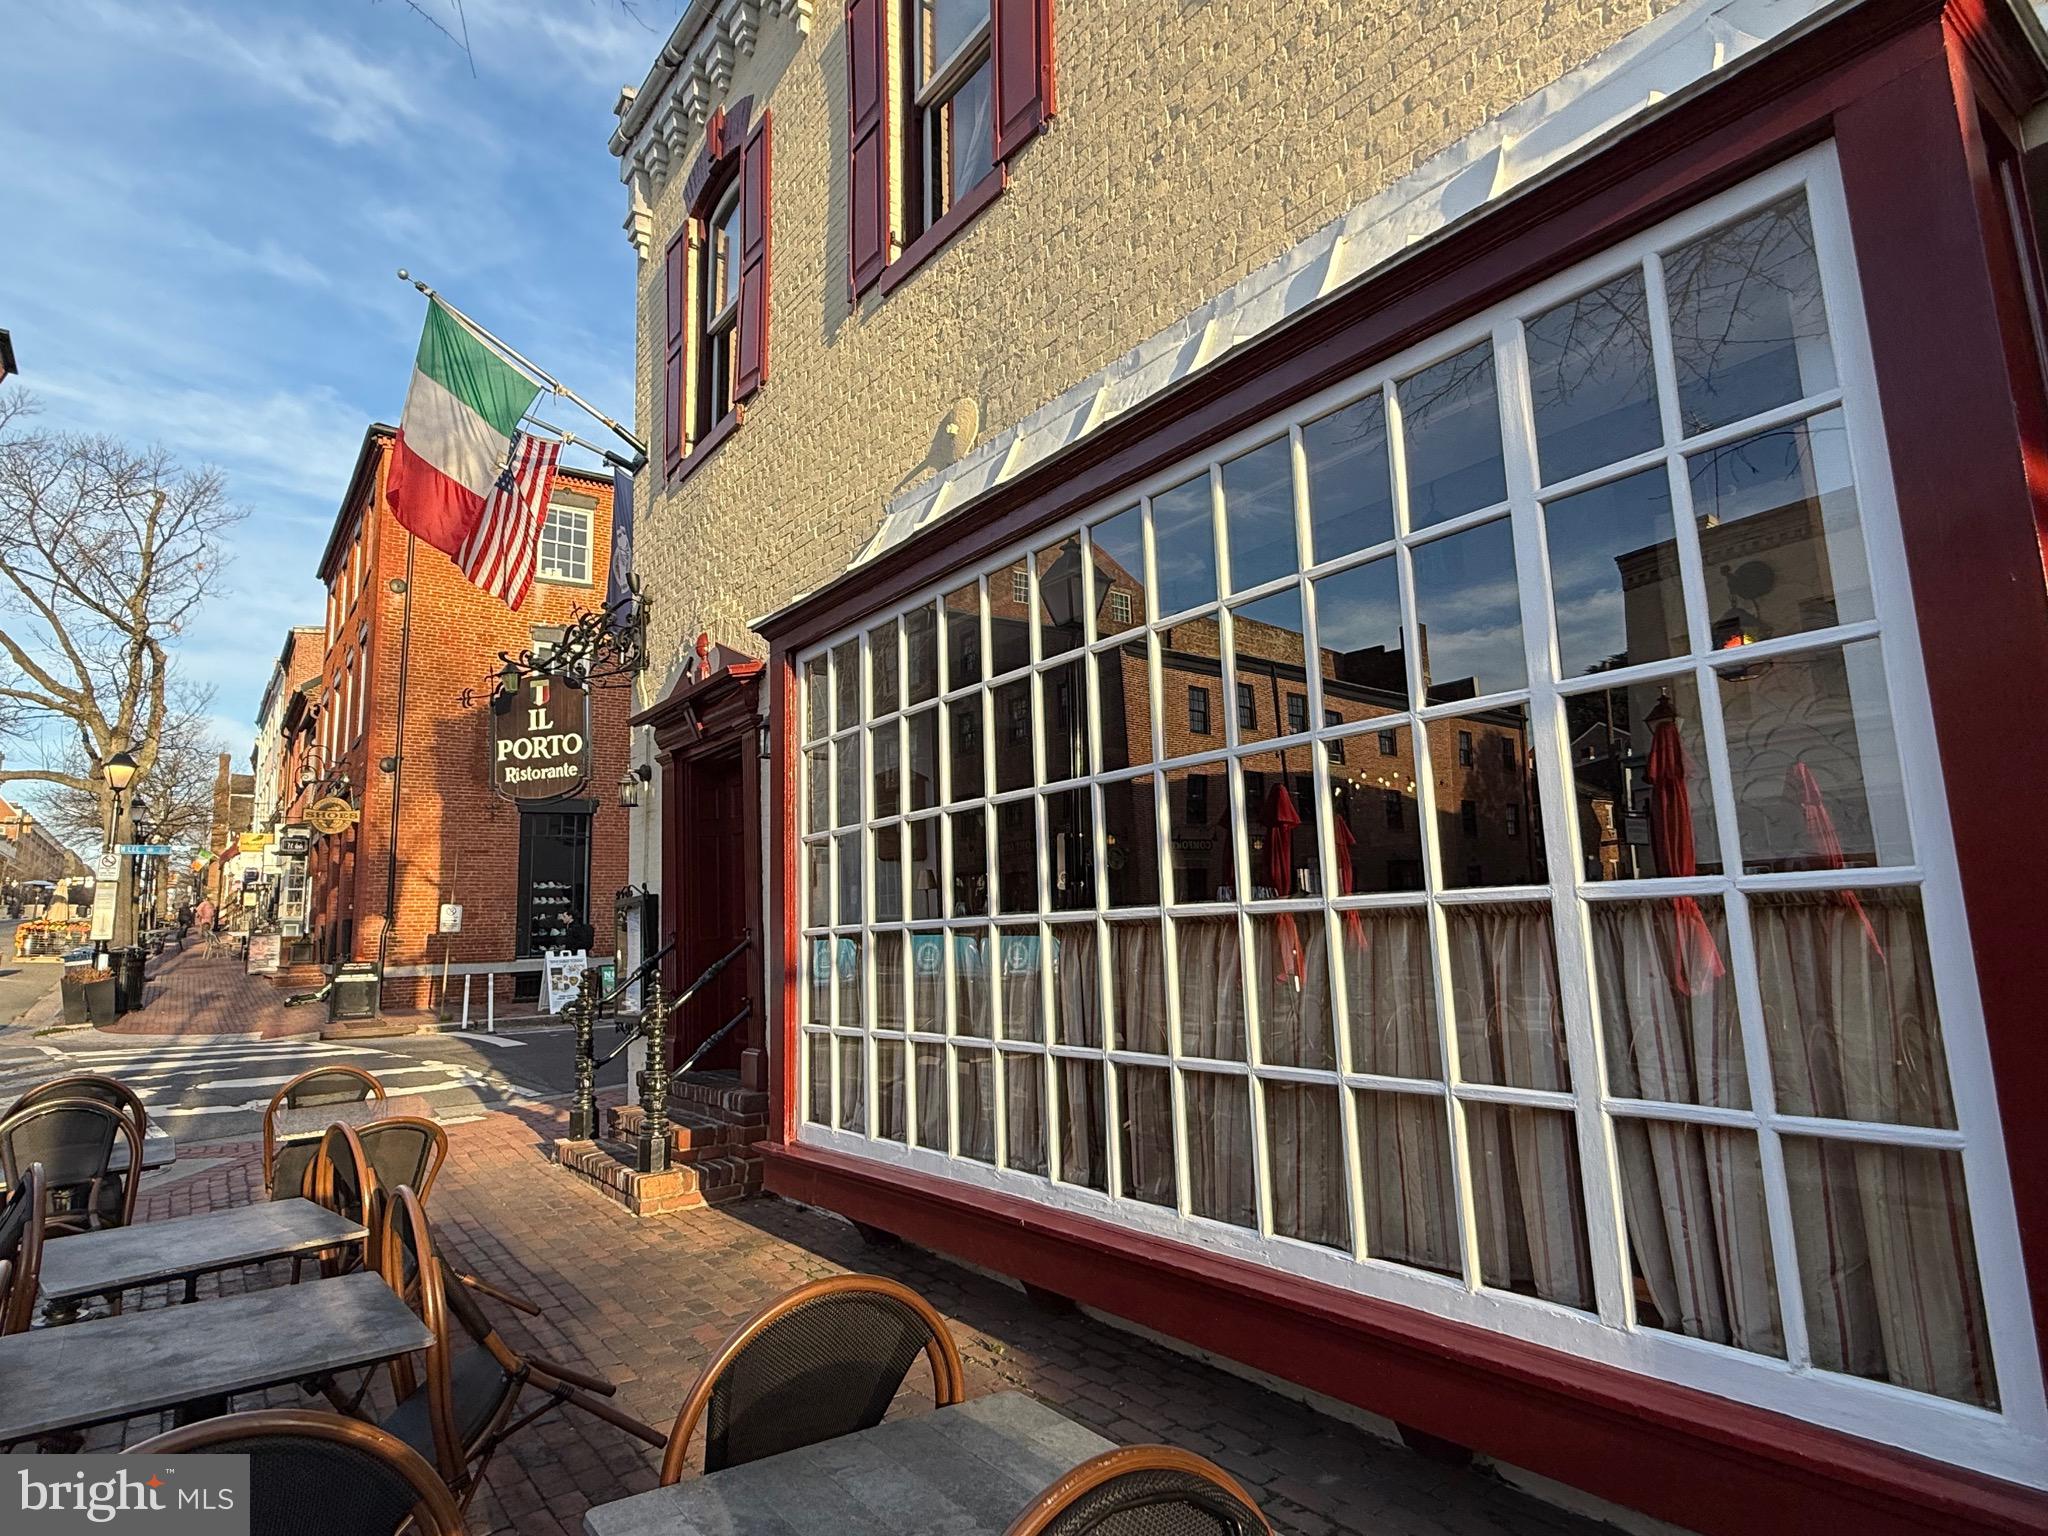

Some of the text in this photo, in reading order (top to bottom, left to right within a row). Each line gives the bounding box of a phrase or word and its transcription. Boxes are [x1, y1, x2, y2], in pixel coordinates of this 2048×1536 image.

[527, 708, 554, 731] IL
[497, 733, 583, 762] PORTO
[504, 762, 578, 784] Ristorante
[304, 811, 359, 820] SHOES
